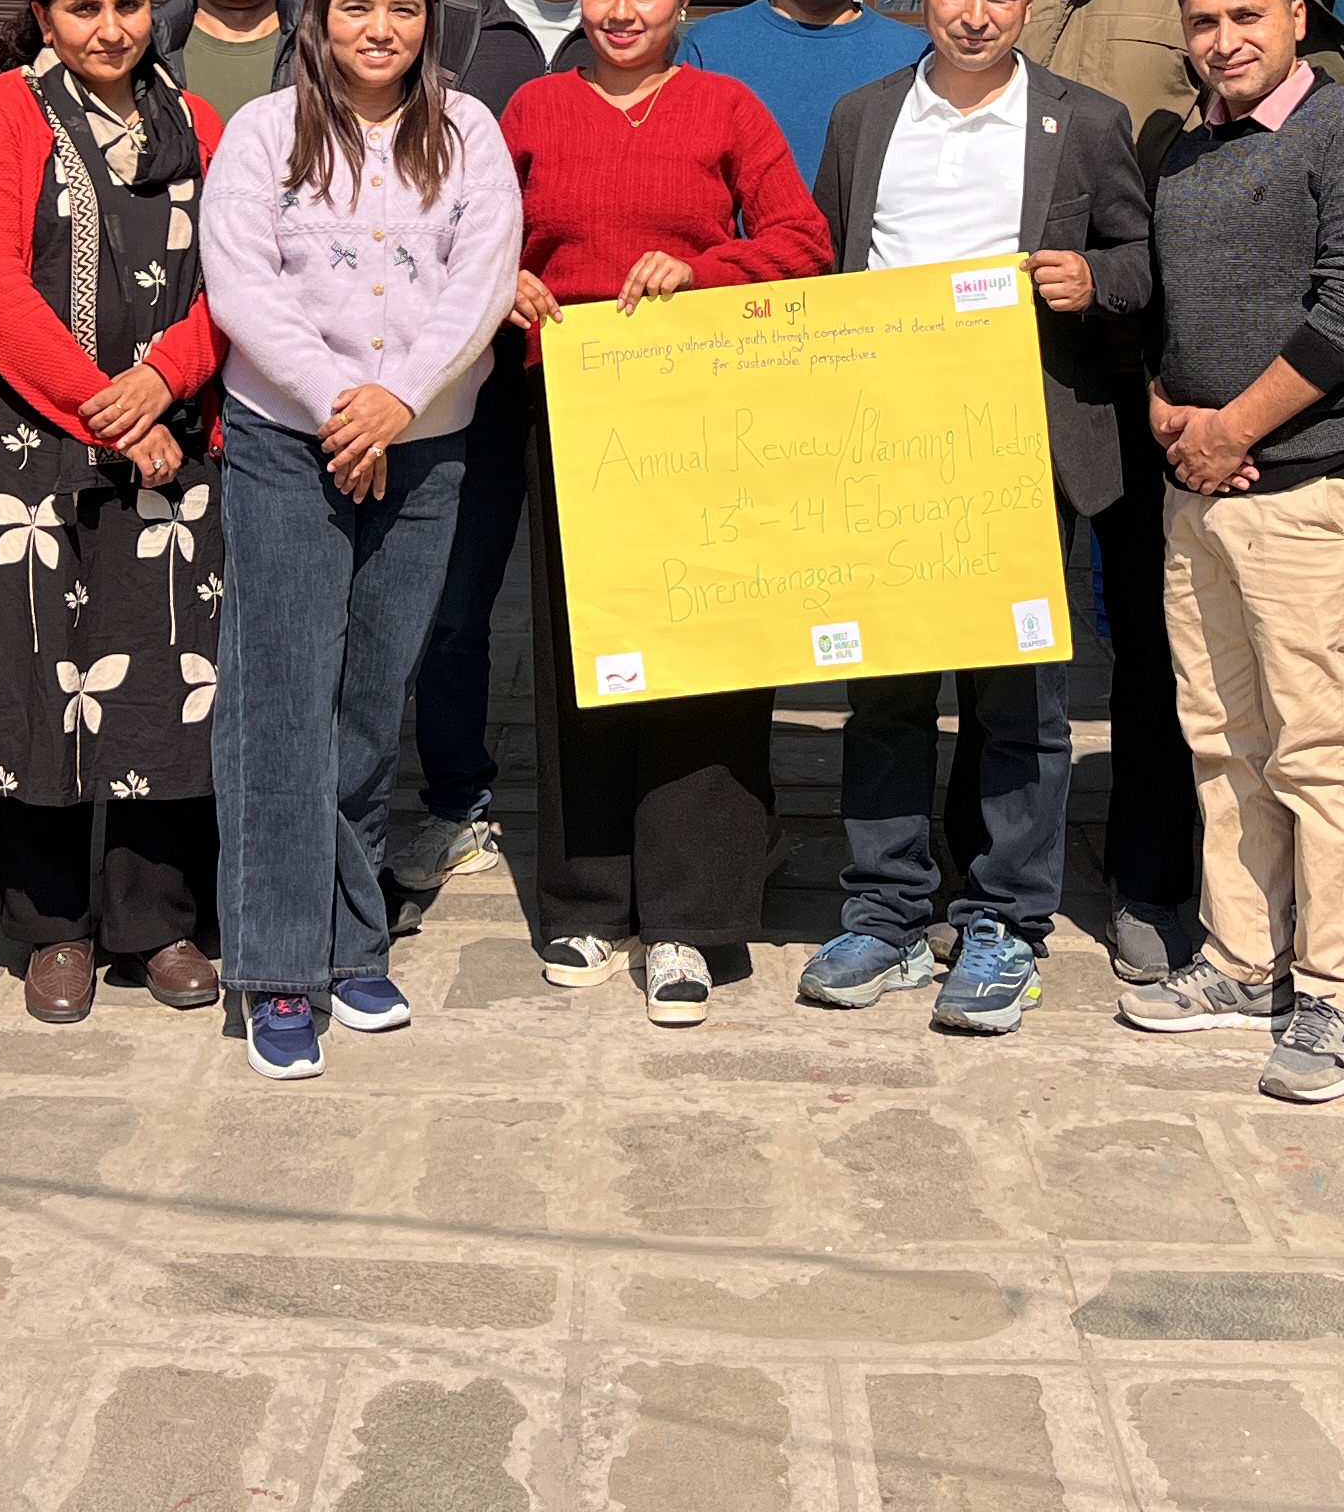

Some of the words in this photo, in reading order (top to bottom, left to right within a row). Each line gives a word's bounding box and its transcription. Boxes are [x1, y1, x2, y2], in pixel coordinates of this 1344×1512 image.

[742, 299, 772, 319] Skill
[582, 341, 674, 381] Empowering
[678, 332, 734, 354] vulnerable
[736, 330, 767, 355] youth
[772, 324, 809, 352] through
[814, 322, 875, 345] competencies
[884, 318, 903, 334] and
[911, 316, 945, 333] decent
[955, 317, 990, 329] income
[712, 358, 730, 376] for
[736, 349, 801, 371] sustainable
[810, 348, 877, 375] perspectives
[592, 415, 709, 492] Annual
[962, 401, 1046, 491] Meeting
[790, 497, 826, 535] 14
[843, 473, 976, 544] February
[981, 486, 1044, 515] 2026
[882, 522, 1002, 587] Surkhet
